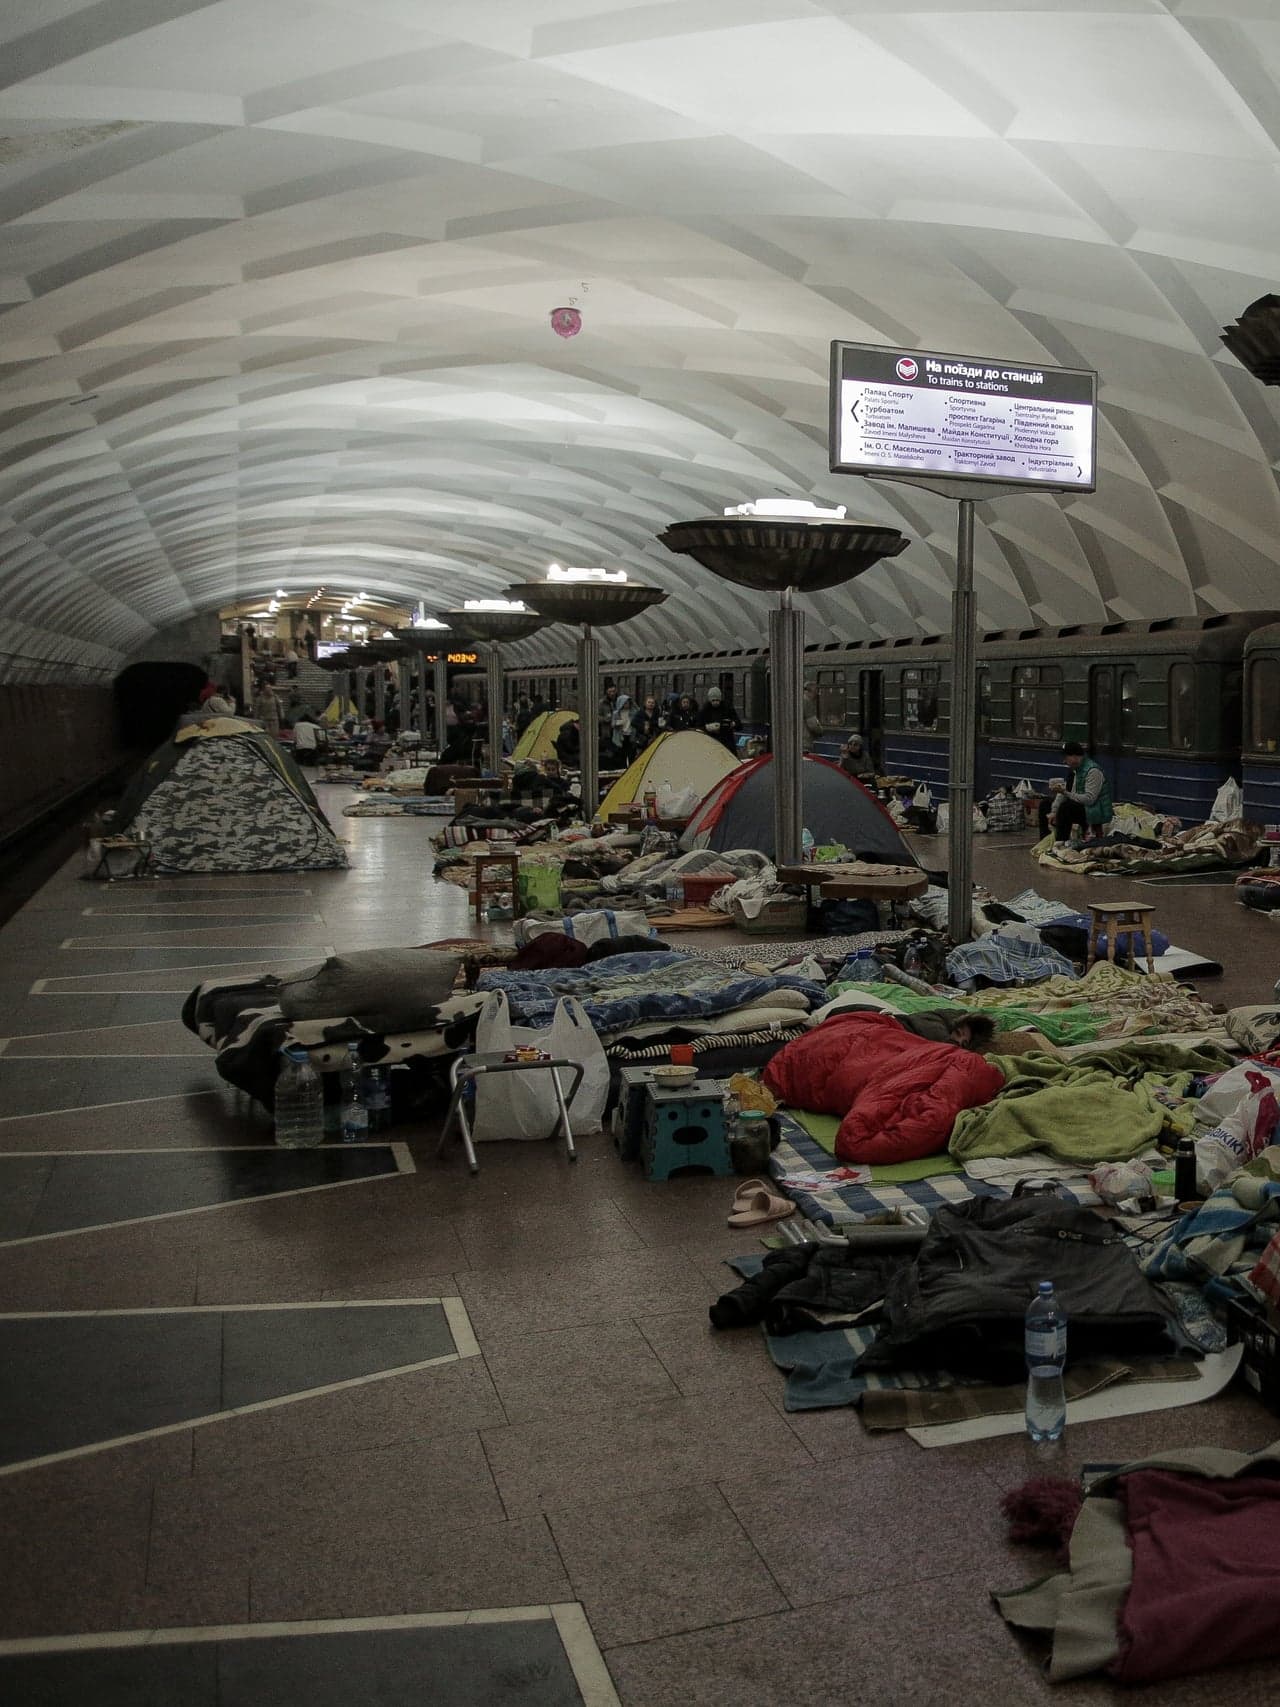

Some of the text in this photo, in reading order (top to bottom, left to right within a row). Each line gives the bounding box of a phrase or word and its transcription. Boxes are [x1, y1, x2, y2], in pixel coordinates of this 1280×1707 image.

[926, 360, 1044, 384] На поїзди до станцій
[927, 375, 1009, 392] To trains to stations
[864, 388, 913, 400] Палац Спорту
[949, 396, 986, 407] Спортивна
[866, 405, 904, 416] Турбоатом
[948, 412, 1005, 425] проспект Гагаріна
[864, 419, 885, 429] Завод
[898, 423, 935, 433] Малишева
[1014, 419, 1074, 431] Південний вокзал
[942, 427, 1009, 441] Майдан Конституції
[1014, 434, 1058, 446] Холодна гора
[893, 445, 942, 456] Масельського
[954, 449, 994, 461] Тракторний
[1028, 457, 1073, 469] Індустріальна
